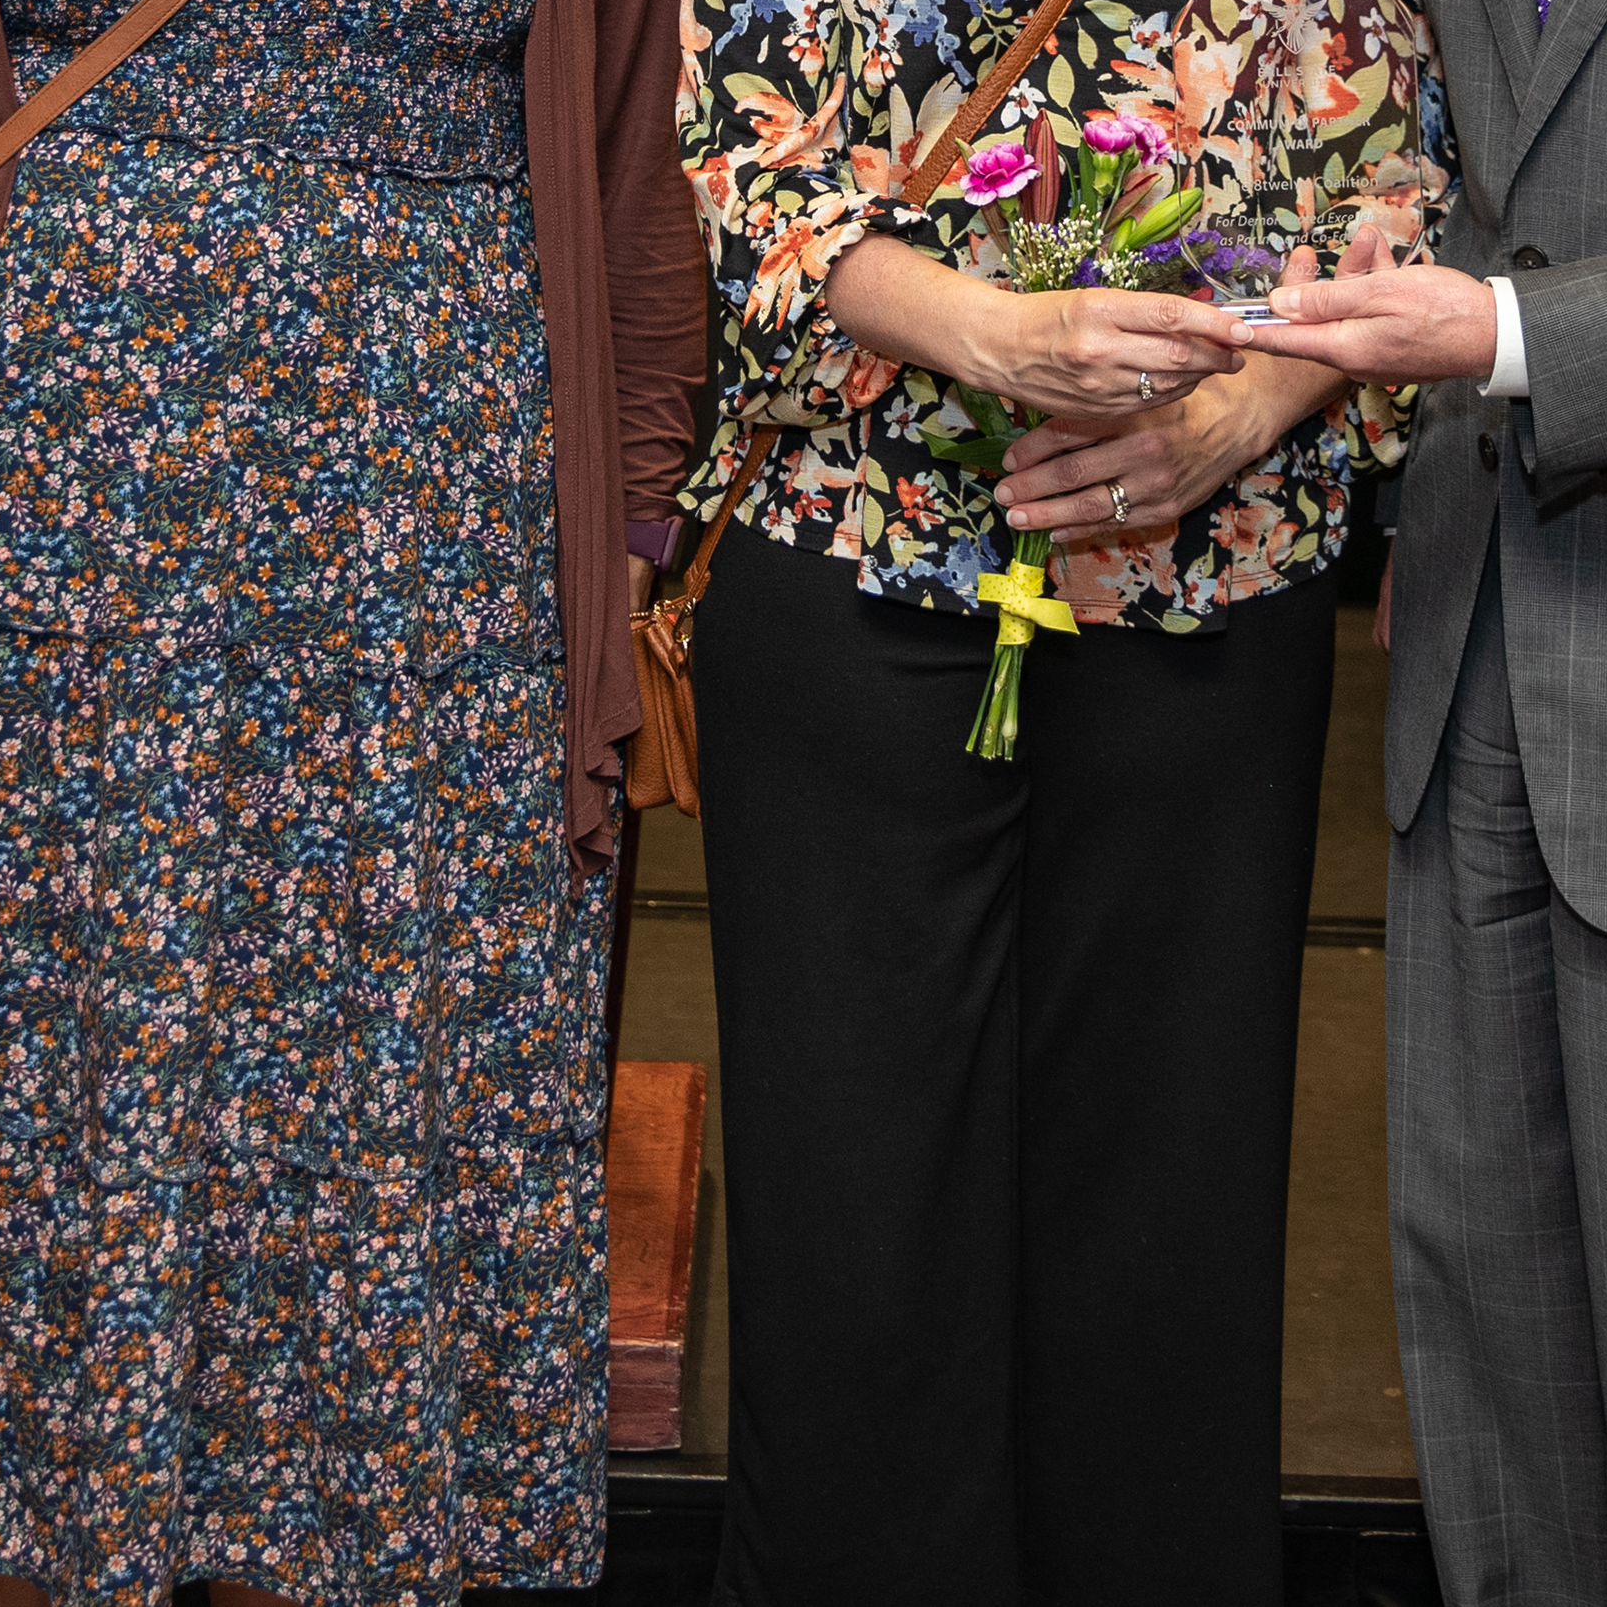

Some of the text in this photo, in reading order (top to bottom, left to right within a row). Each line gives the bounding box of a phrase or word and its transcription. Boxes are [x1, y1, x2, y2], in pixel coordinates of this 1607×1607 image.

[1258, 65, 1336, 78] BLL SAE
[1262, 79, 1331, 89] UNIVERIT
[1227, 116, 1371, 132] COMMUN PARTR
[1276, 138, 1324, 150] AWARD
[1254, 178, 1312, 192] 8twelv
[1315, 175, 1378, 189] Coalition
[1215, 216, 1235, 228] For
[1238, 213, 1325, 227] Demonaed
[1220, 229, 1384, 246] as Parn nd Co-Educat
[1288, 264, 1322, 276] 2022
